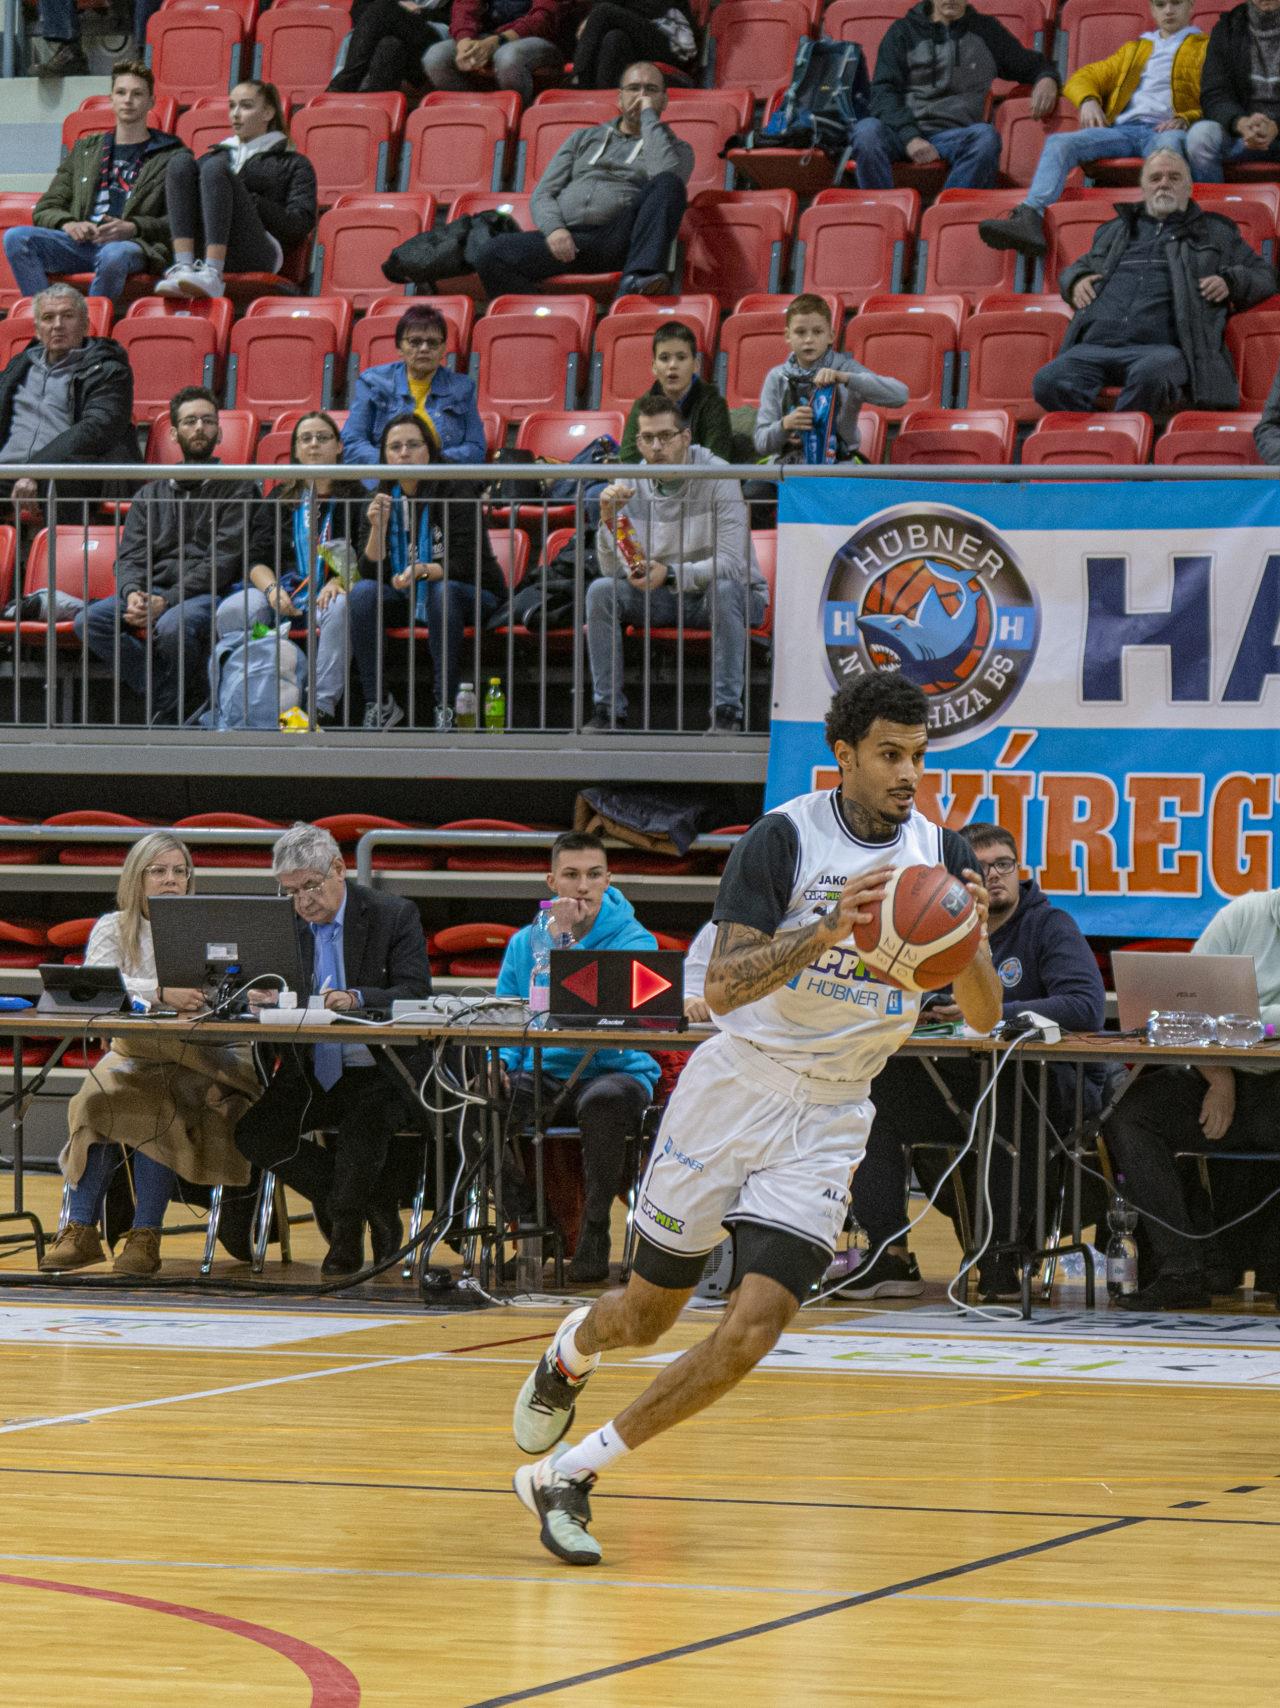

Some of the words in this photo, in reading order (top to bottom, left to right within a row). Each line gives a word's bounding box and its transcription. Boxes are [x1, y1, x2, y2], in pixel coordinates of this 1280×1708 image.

[853, 523, 1005, 580] HÜBNER
[984, 654, 1014, 690] BS
[818, 874, 848, 886] JAKO
[807, 976, 880, 1008] HÜBNER
